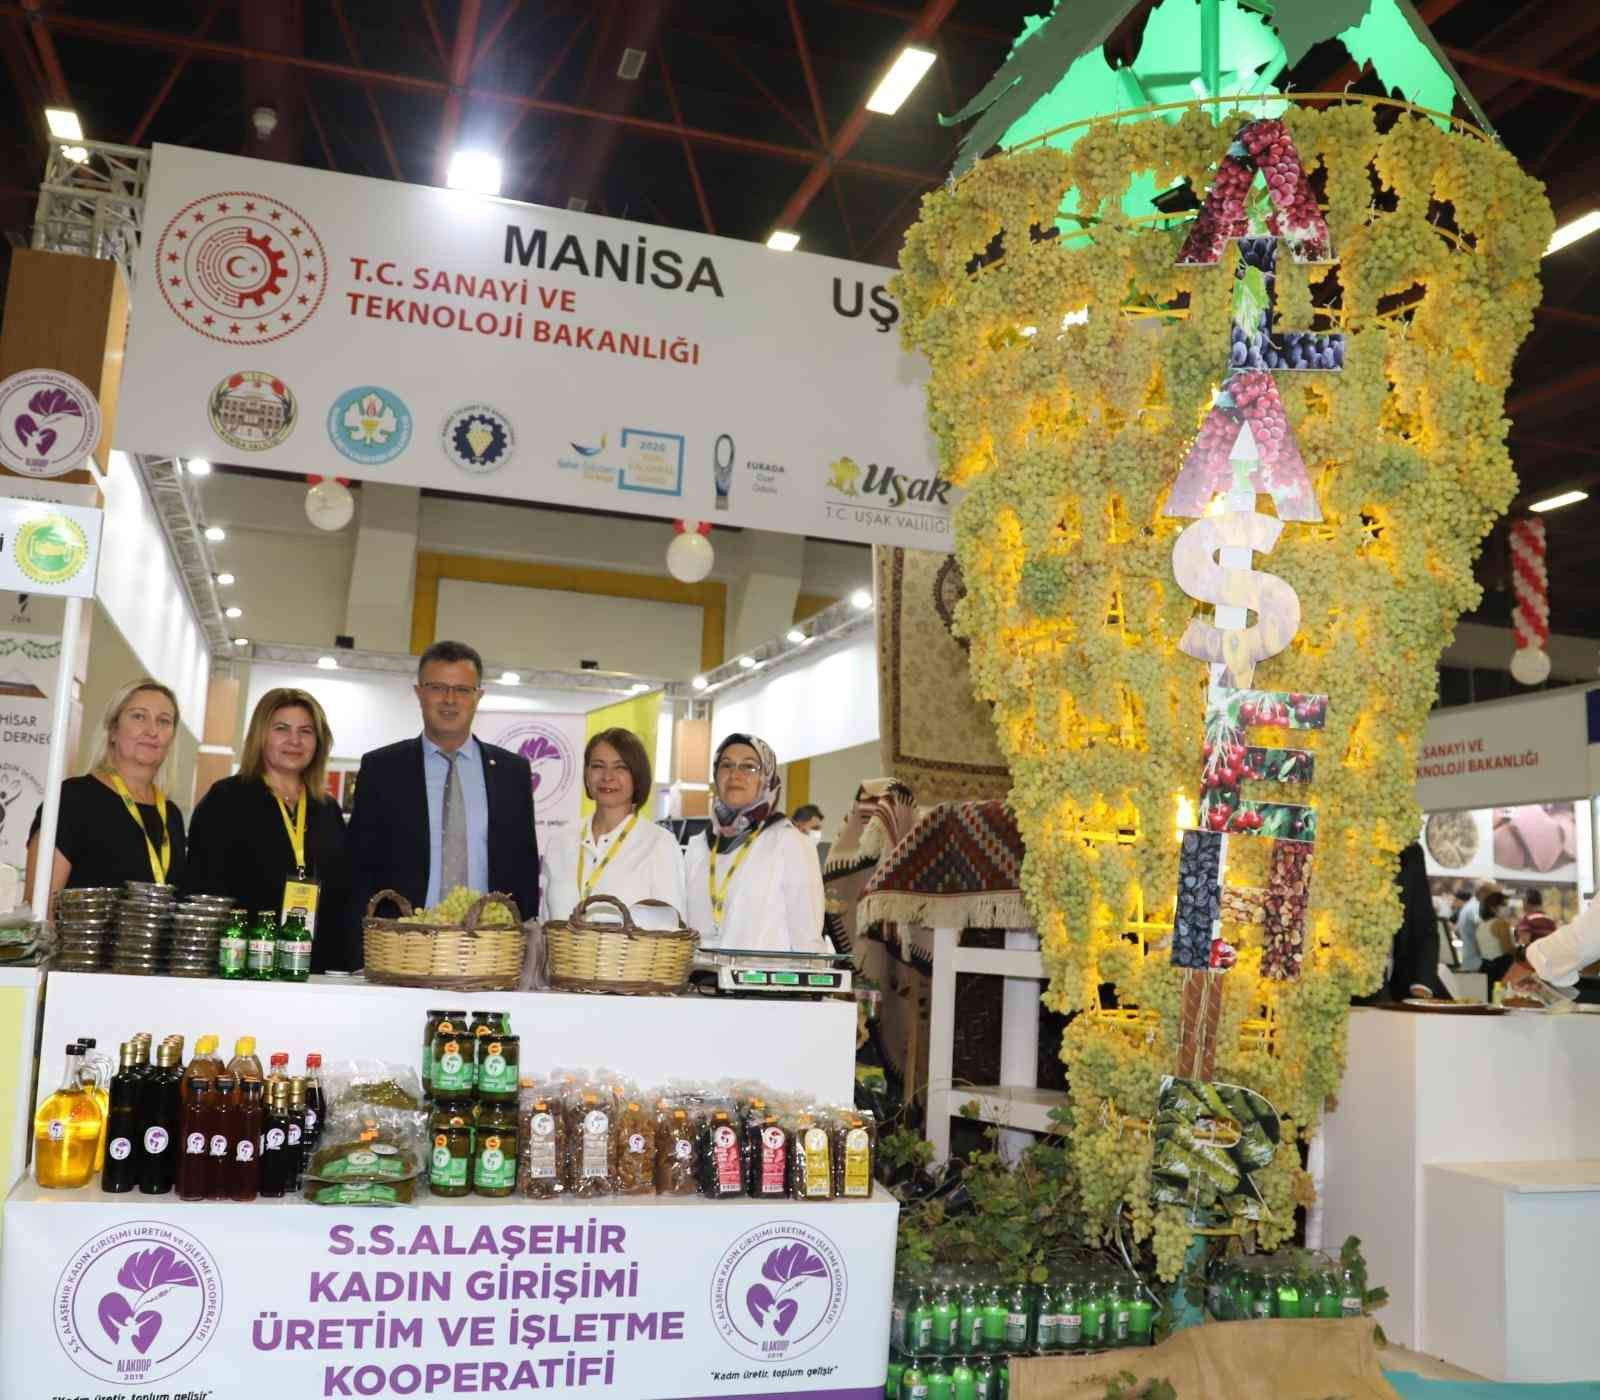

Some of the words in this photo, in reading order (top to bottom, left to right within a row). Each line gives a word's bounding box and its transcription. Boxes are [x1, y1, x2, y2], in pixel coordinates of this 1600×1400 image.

[503, 224, 724, 298] MANİSA
[350, 258, 403, 286] T.C.
[413, 267, 528, 305] SANAYİ
[538, 286, 577, 313] VE
[346, 292, 523, 339] TEKNOLOJİ
[533, 319, 700, 366] BAKANLIĞI
[862, 463, 952, 507] Uşak
[855, 510, 891, 529] UŞAK
[1468, 738, 1485, 753] VE
[1468, 750, 1539, 773] BAKANLIĞI
[328, 1217, 627, 1261] S.S.ALAŞEHİR
[67, 1253, 91, 1283] KADIN
[309, 1270, 451, 1302] KADIN
[465, 1261, 639, 1305] GİRİŞİMİ
[252, 1311, 423, 1351] ÜRETİM
[438, 1316, 496, 1347] VE
[508, 1308, 685, 1350] İŞLETME
[117, 1359, 152, 1373] ALAKOOP
[323, 1350, 615, 1397] KOOPERATİFİ
[772, 1367, 804, 1379] toplum
